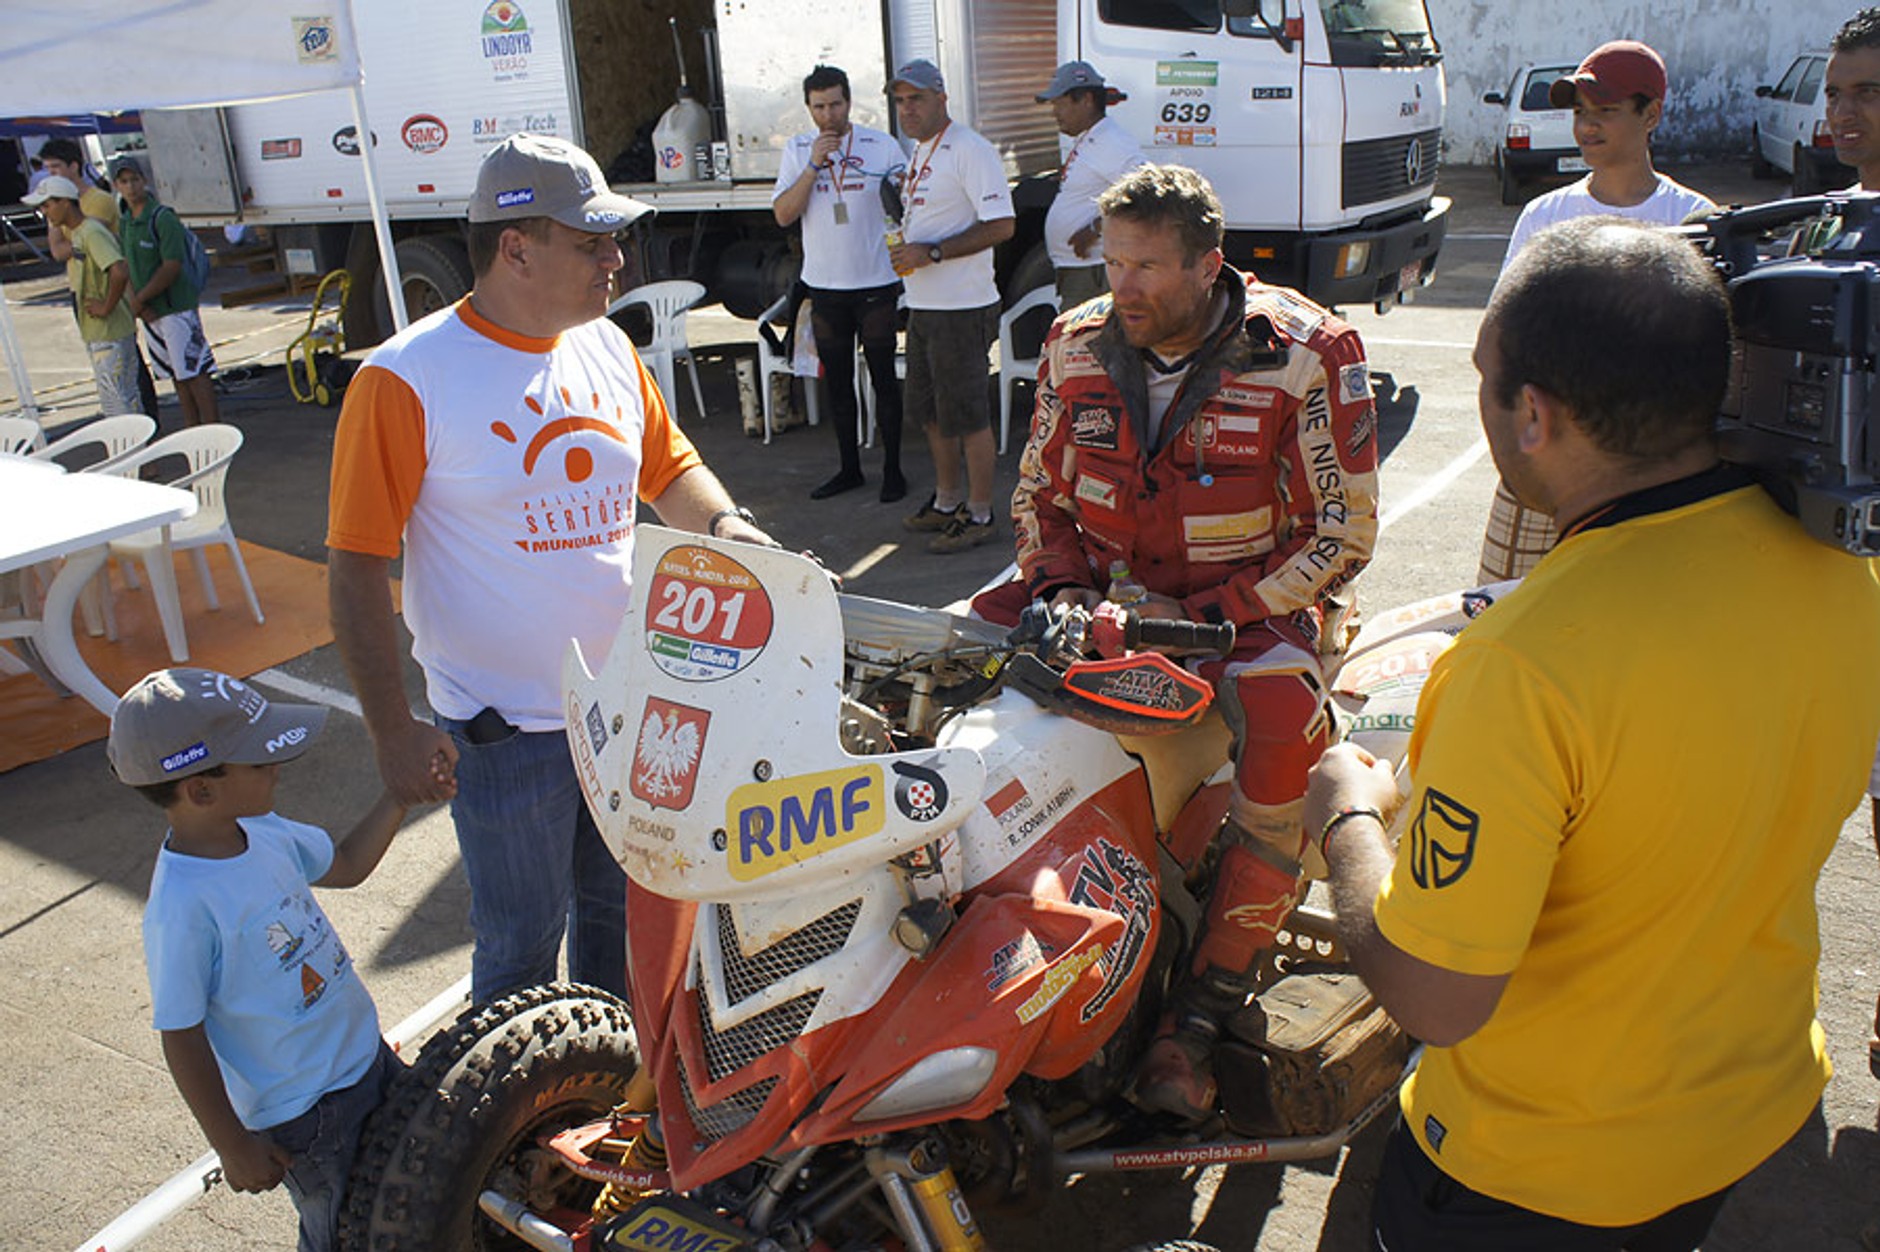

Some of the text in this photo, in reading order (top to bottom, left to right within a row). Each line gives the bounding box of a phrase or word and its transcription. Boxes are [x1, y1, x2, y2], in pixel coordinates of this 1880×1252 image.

[1170, 88, 1204, 98] APOIO
[1161, 102, 1212, 124] 639
[409, 127, 441, 144] BMC
[1306, 387, 1328, 433] NIE
[1217, 444, 1260, 455] POLAND
[532, 533, 604, 553] MUNDIAL
[655, 580, 746, 641] 201
[691, 646, 737, 667] Gillette
[1353, 651, 1428, 684] 201
[162, 745, 207, 771] Gillette
[739, 776, 872, 864] RMF
[910, 805, 939, 820] PZM
[998, 796, 1033, 826] POLAND
[628, 814, 677, 842] POLAND
[1115, 1144, 1264, 1166] www.atvpolska.pl
